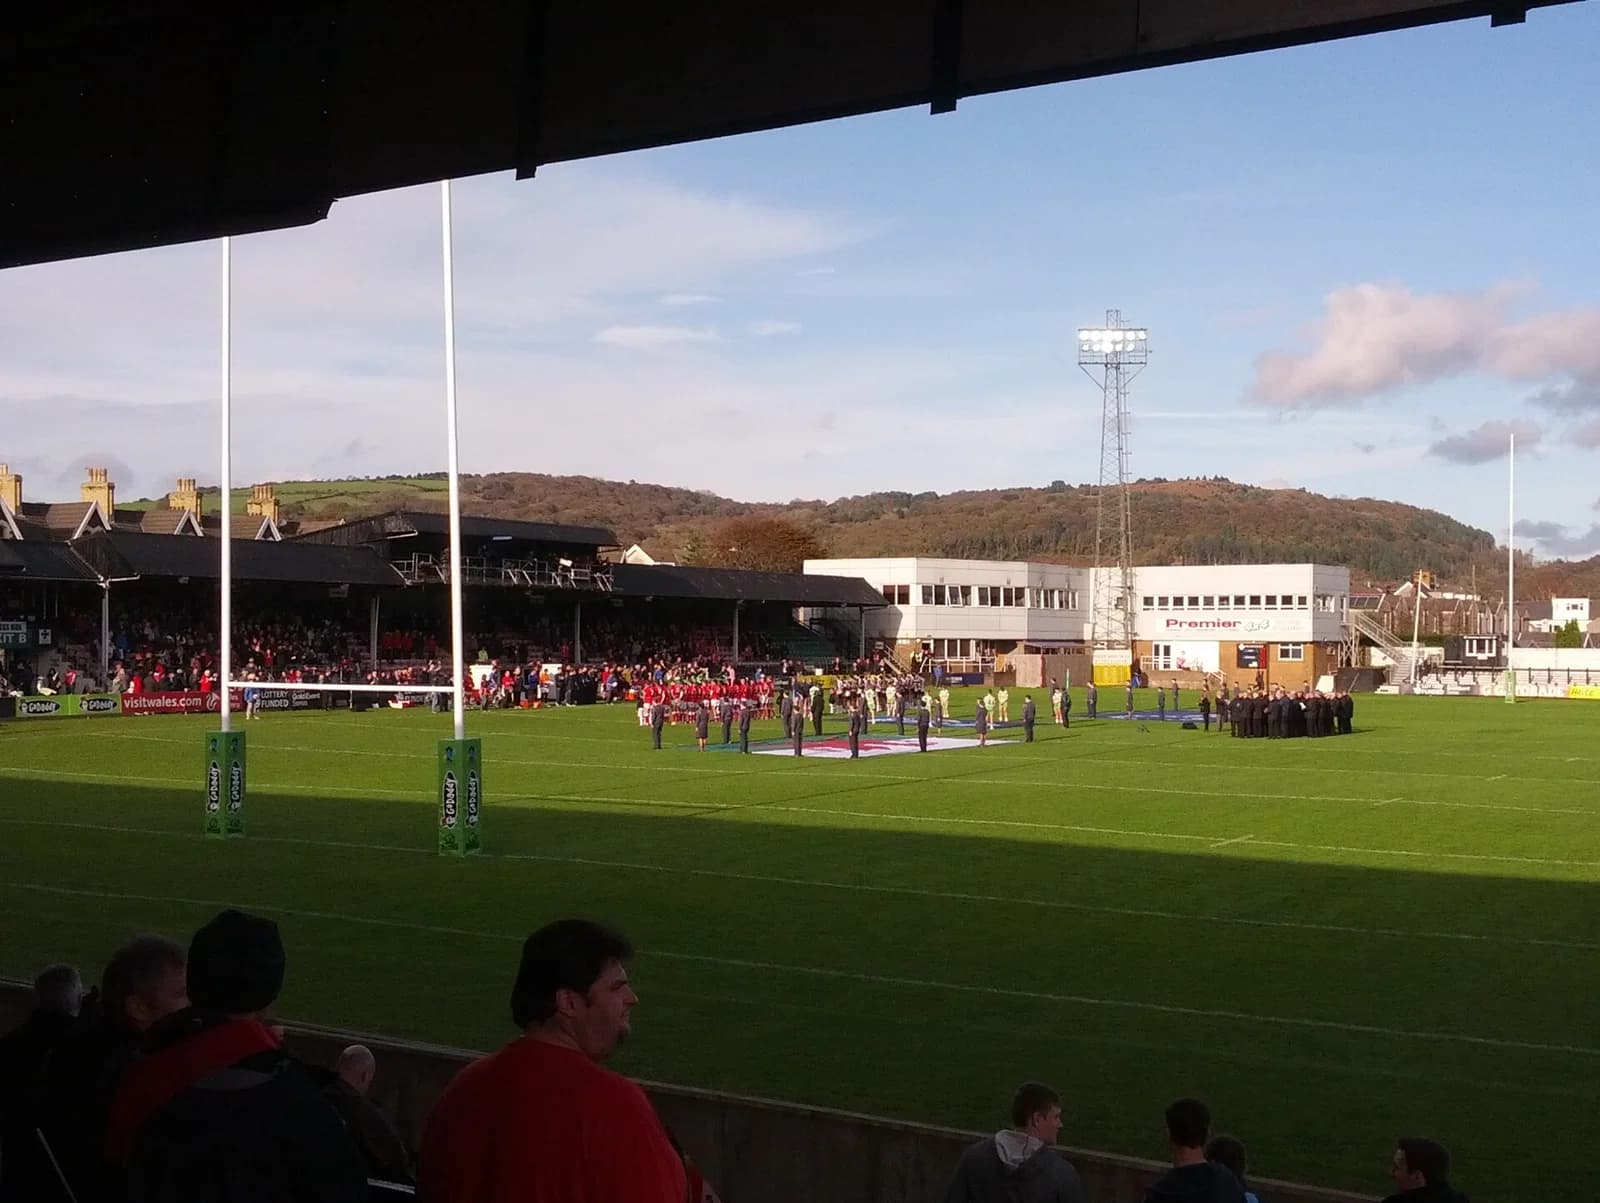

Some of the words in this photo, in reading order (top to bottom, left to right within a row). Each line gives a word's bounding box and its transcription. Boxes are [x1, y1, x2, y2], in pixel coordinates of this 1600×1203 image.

[1166, 618, 1242, 628] Premier
[261, 690, 288, 699] LOTTERY
[124, 695, 202, 708] visitwales.com
[261, 699, 289, 708] FUNDED
